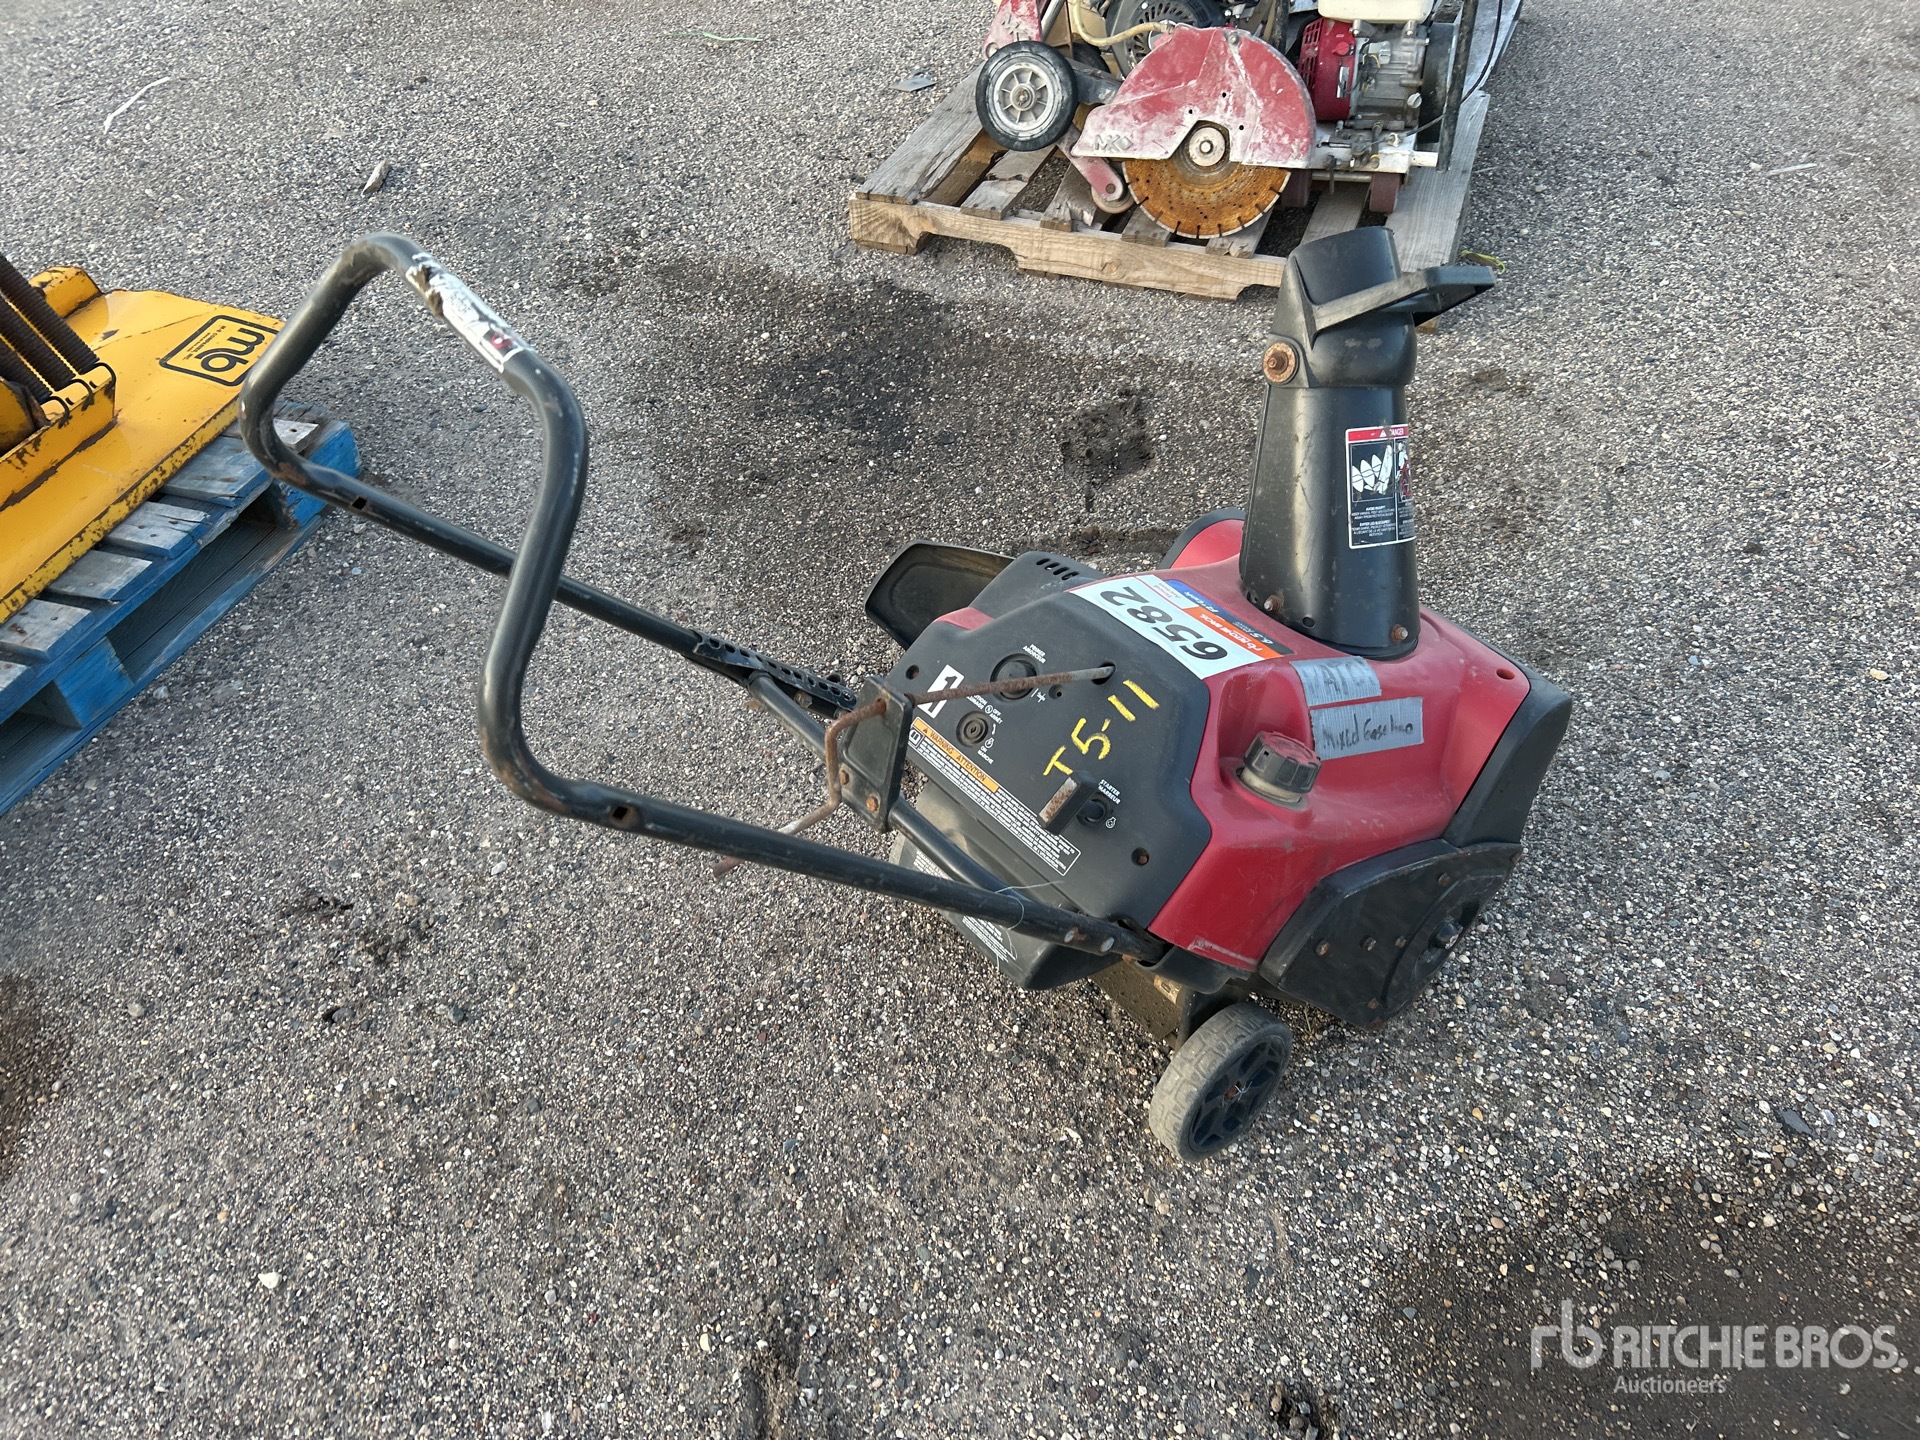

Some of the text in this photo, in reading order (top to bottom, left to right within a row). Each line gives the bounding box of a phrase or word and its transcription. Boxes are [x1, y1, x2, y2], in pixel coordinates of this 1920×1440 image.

[1095, 135, 1121, 153] MK
[195, 328, 265, 372] mb
[1100, 586, 1228, 660] 6582
[1030, 644, 1046, 657] PRIMER
[992, 707, 1001, 716] OFF
[929, 731, 987, 782] WARNING ATTENTION
[979, 744, 988, 753] ON
[1099, 778, 1120, 796] STARTER
